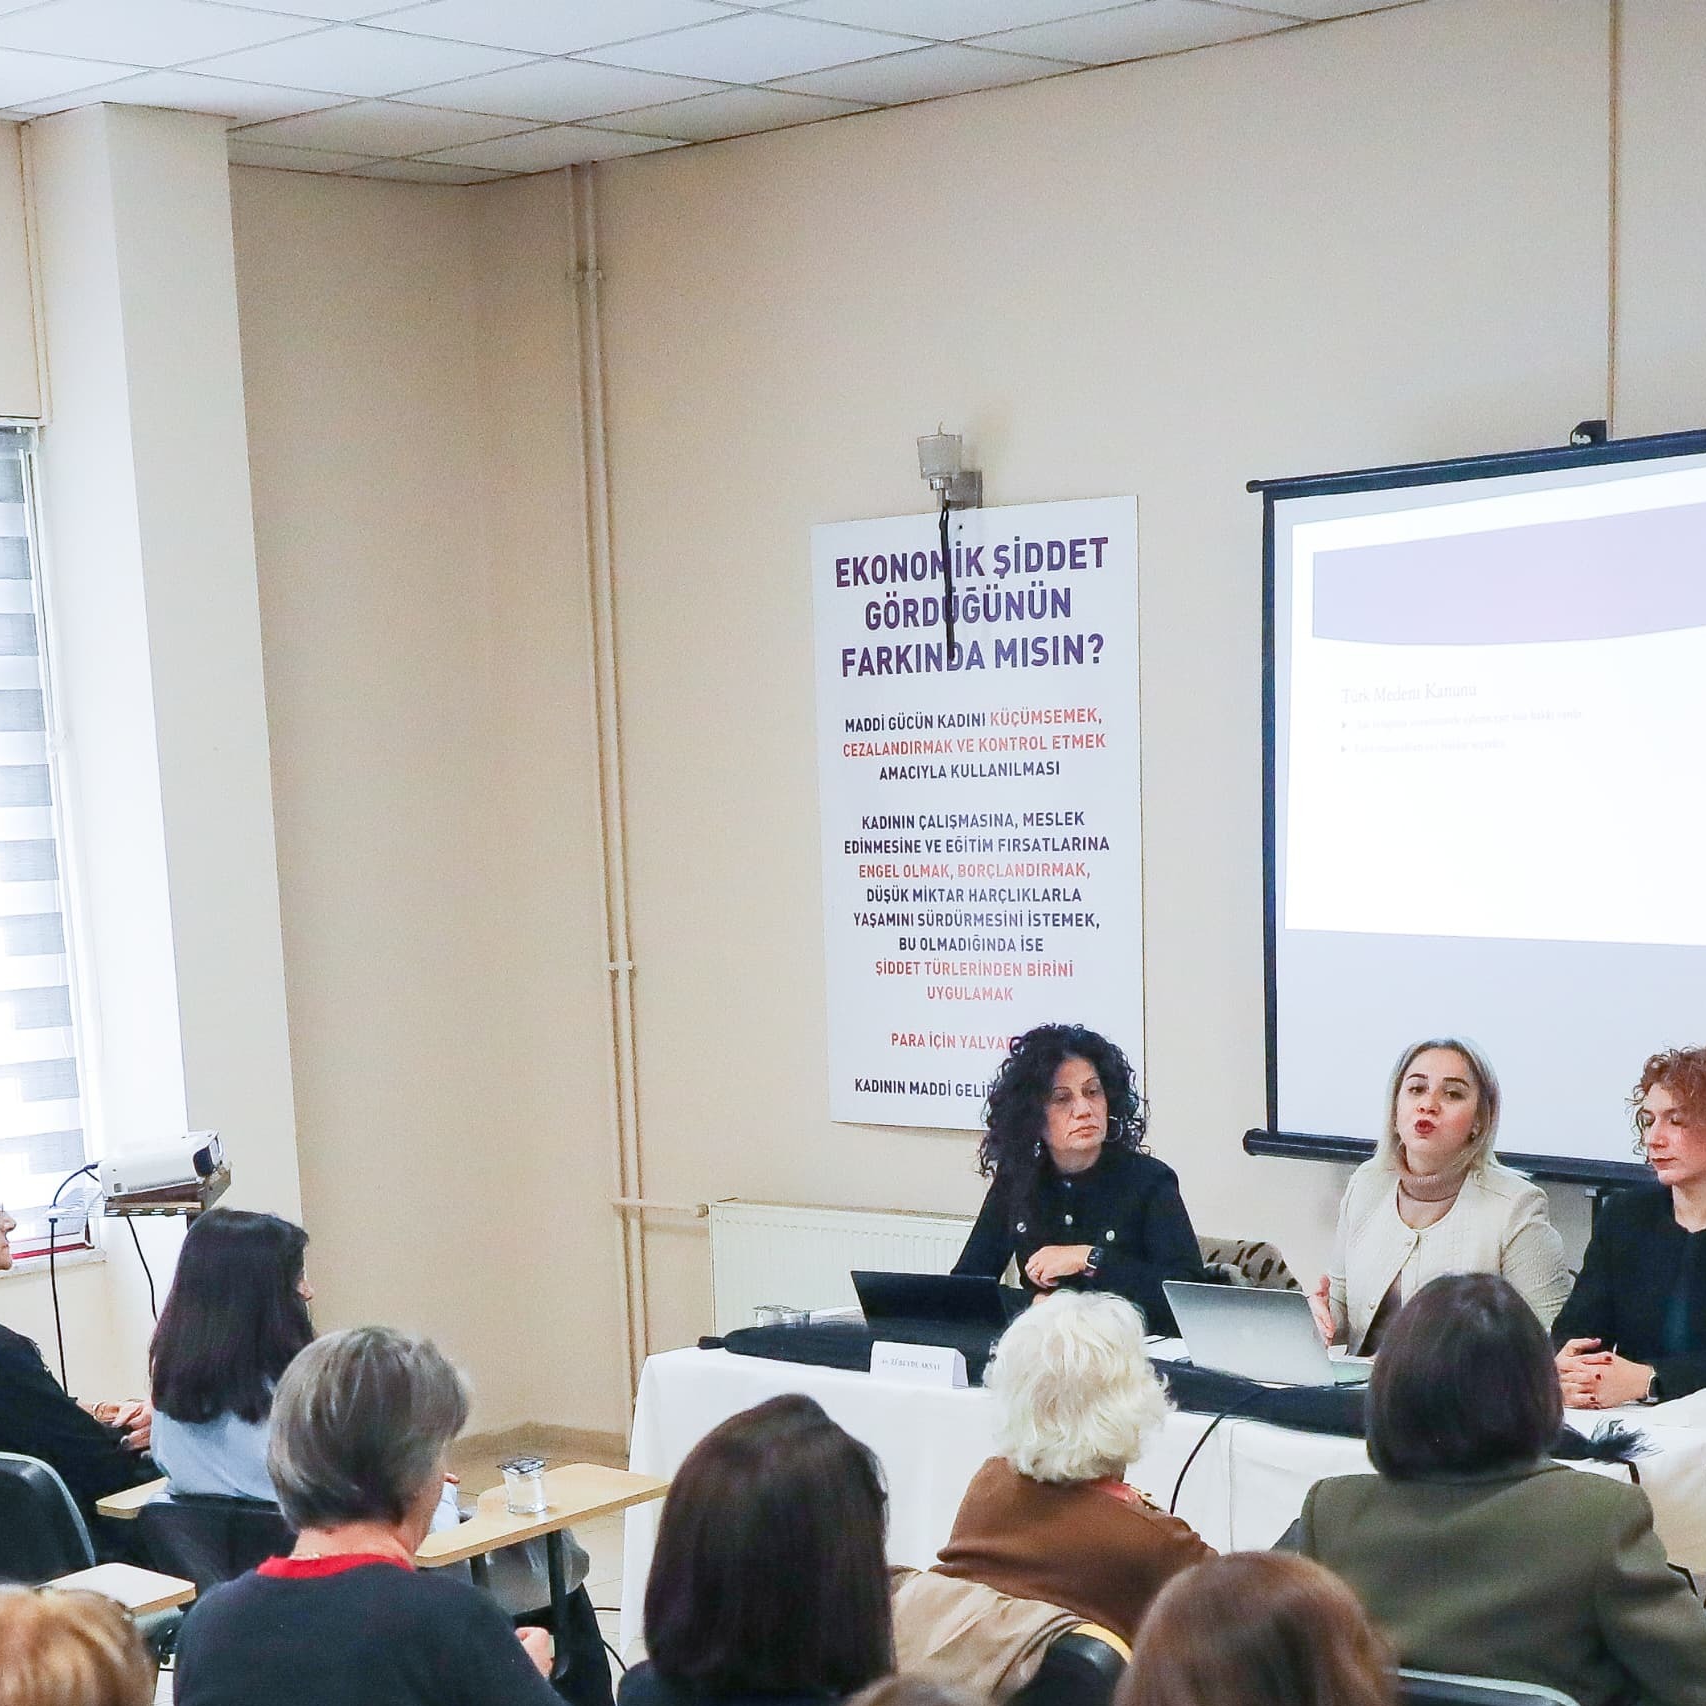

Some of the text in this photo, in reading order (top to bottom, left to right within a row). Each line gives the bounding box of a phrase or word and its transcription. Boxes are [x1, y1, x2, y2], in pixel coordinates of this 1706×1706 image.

[836, 537, 1108, 587] EKONOMİK ŞİDDET
[866, 581, 1071, 630] GÖRDÜĞÜNÜN
[842, 634, 1104, 677] FARKINDA MISIN?
[845, 708, 1102, 732] MADDİ GÜCÜN KADINI KÜÇÜMSEMEK,
[843, 734, 1106, 757] CEZALANDIRMAK VE KONTROL ETMEK
[879, 762, 1059, 780] AMACIYLA KULLANILMASI
[862, 812, 1084, 830] KADININ ÇALIŞMASINA, MESLEK
[845, 836, 1109, 854] EDİNMESİNE VE EĞİTİM FIRSATLARINA
[859, 864, 1090, 879] ENGEL OLMAK, BORÇLANDIRMAK,
[867, 885, 1081, 903] DÜŞÜK MİKTAR HARÇLIKLARLA
[854, 910, 1100, 929] YAŞAMINI SÜRDÜRMESİNİ İSTEMEK,
[899, 935, 1043, 952] BU OLMADIĞINDA İSE
[876, 959, 1073, 977] ŞİDDET TÜRLERİNDEN BİRİNİ
[928, 987, 1013, 1000] UYGULAMAK
[891, 1034, 926, 1047] PARA
[929, 1031, 955, 1049] İÇİN
[855, 1079, 905, 1094] KADININ
[909, 1080, 951, 1096] MADDİ
